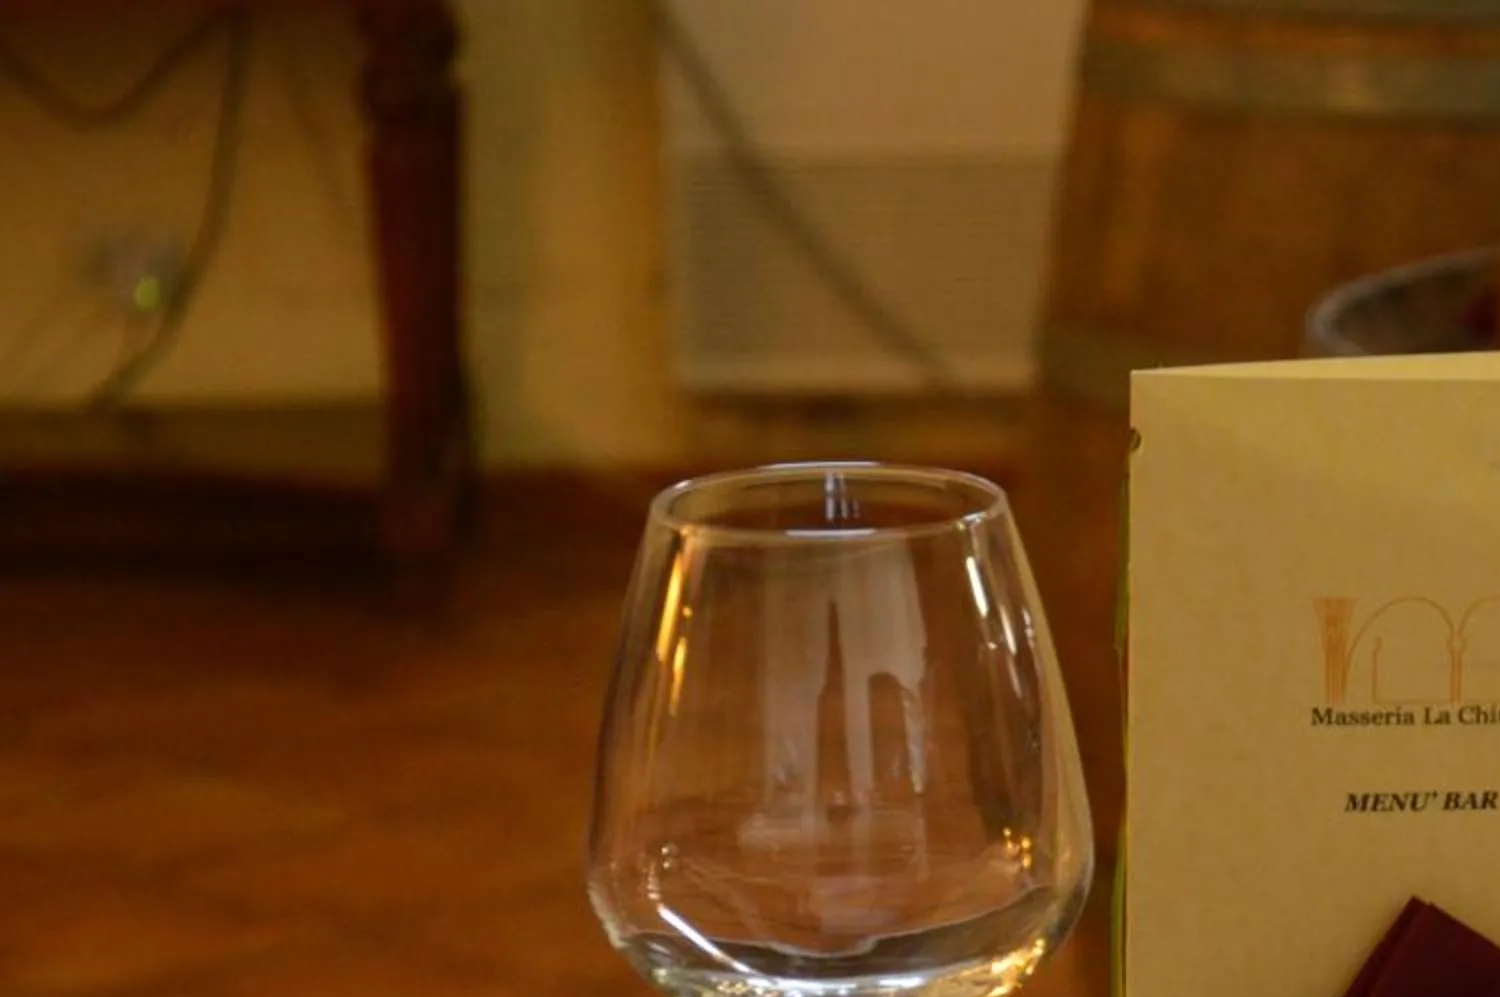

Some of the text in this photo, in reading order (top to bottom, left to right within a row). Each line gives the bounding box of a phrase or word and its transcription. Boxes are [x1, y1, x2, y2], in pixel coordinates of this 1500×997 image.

[1310, 706, 1415, 726] Masseria
[1424, 706, 1451, 725] La
[1443, 790, 1500, 811] BAR
